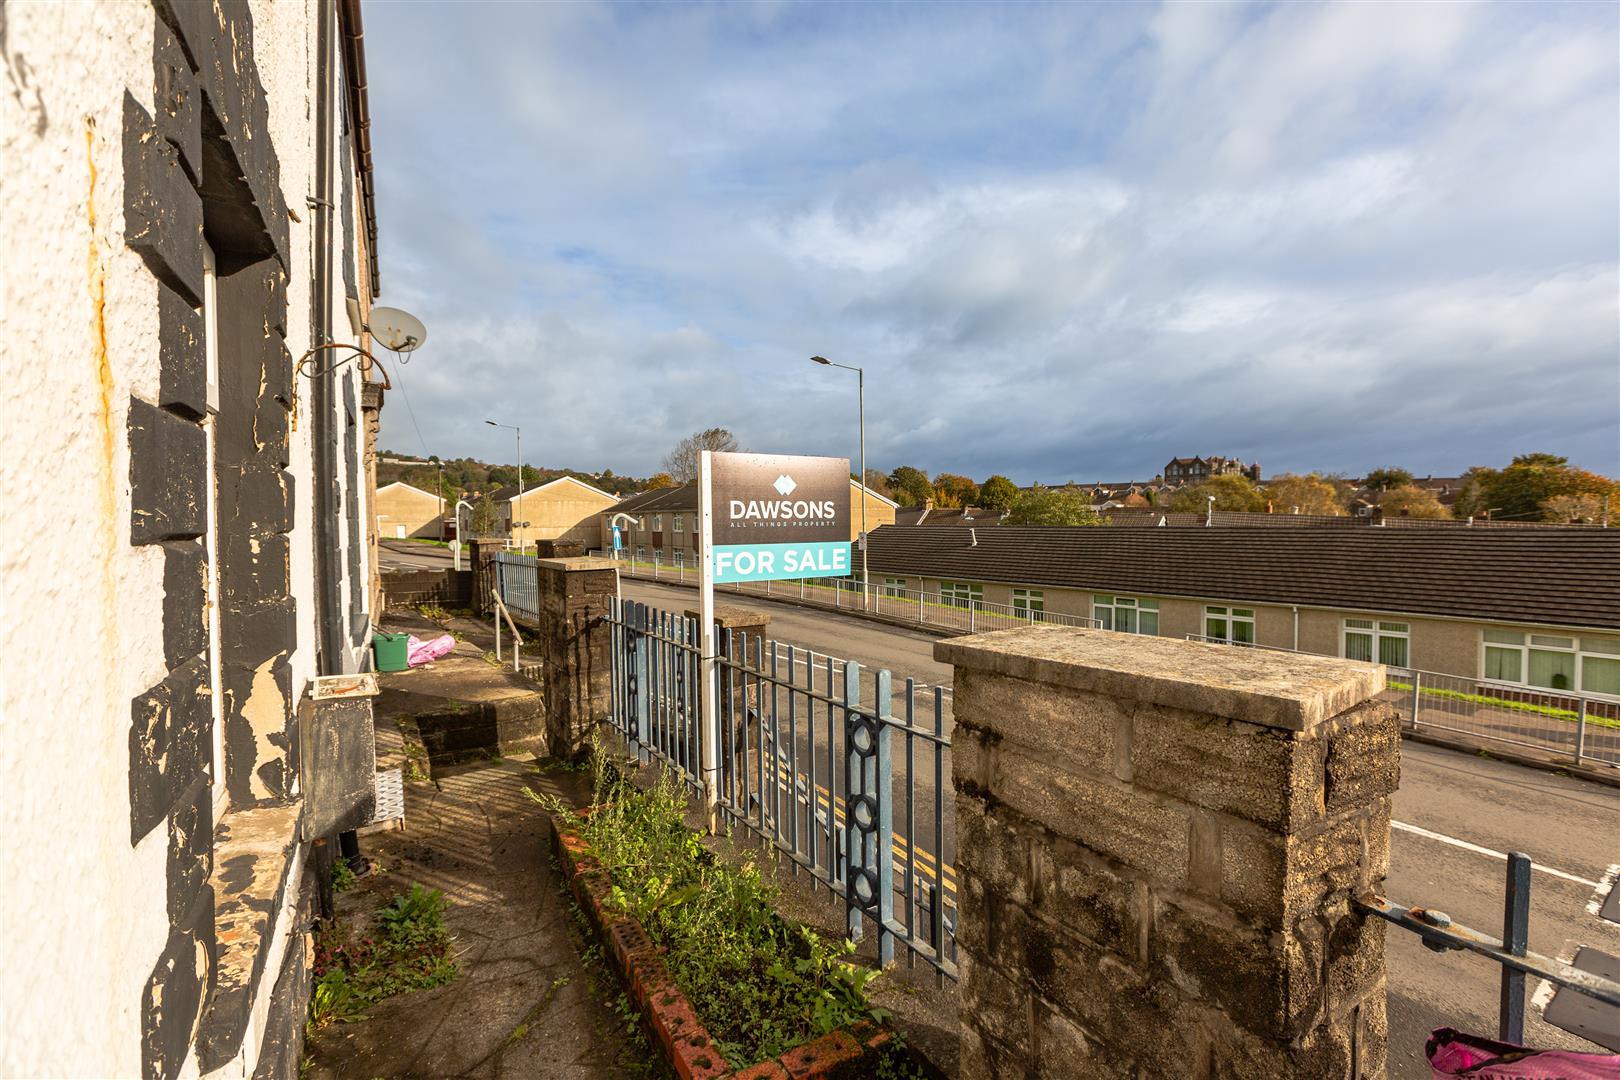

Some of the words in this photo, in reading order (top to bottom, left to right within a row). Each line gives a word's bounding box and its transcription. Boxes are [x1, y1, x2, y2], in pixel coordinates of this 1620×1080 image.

[730, 500, 836, 519] DAWSONS
[716, 551, 775, 576] FOR
[783, 548, 846, 573] SALE
